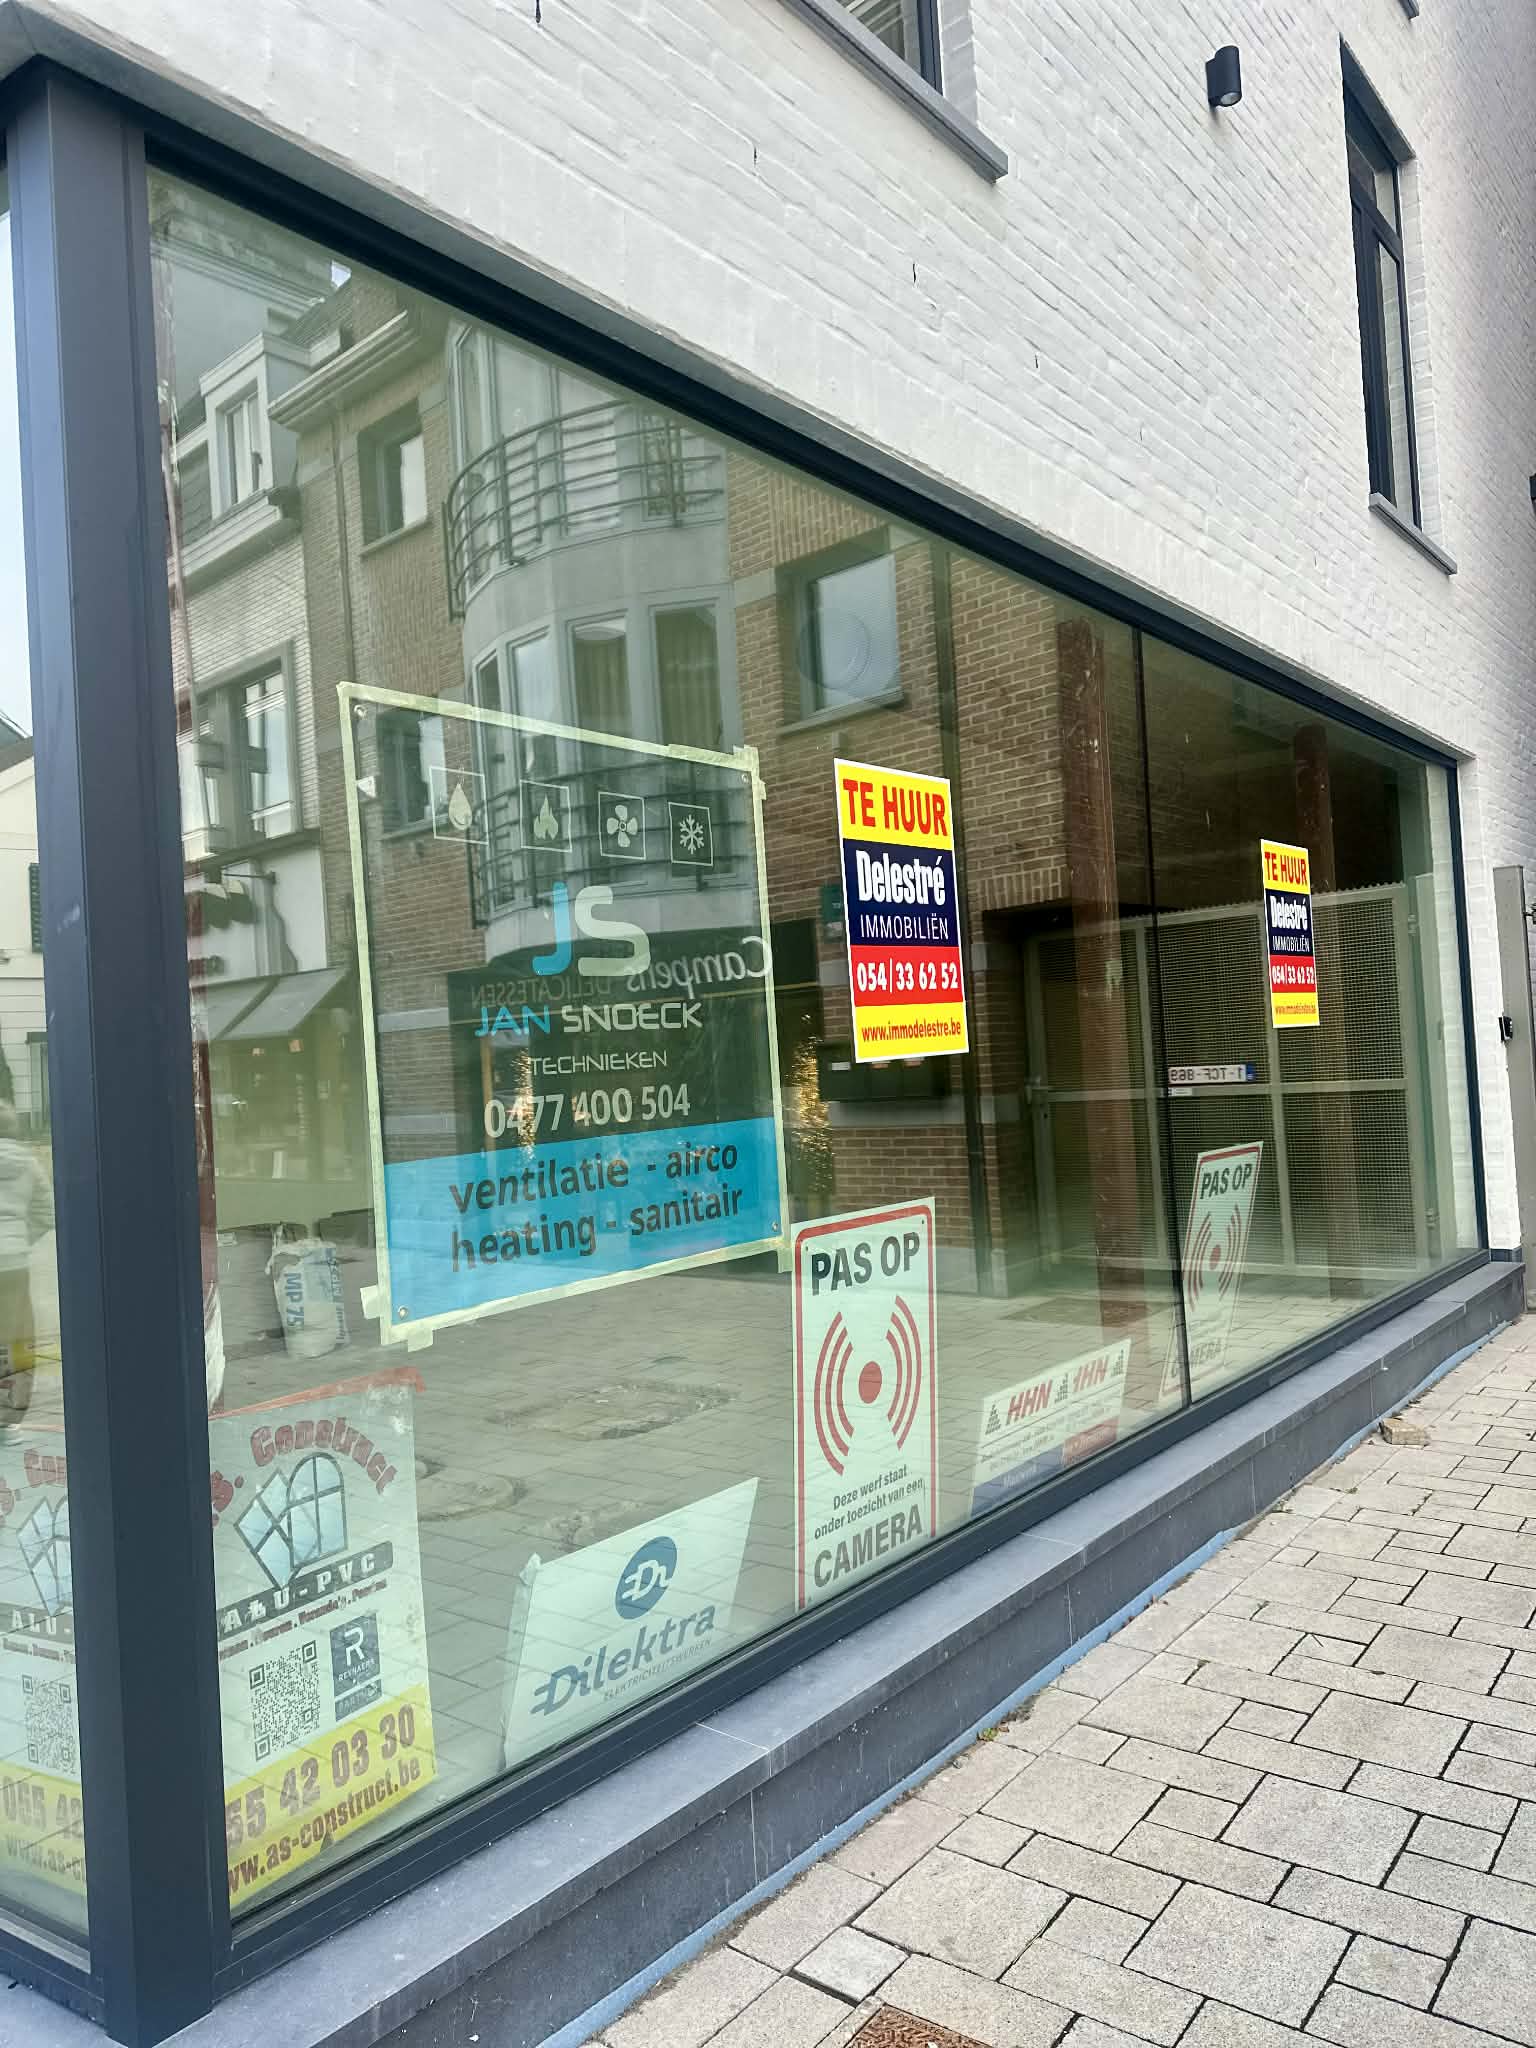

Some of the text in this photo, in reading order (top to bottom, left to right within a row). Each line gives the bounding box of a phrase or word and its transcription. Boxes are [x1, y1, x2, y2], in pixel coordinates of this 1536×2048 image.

[842, 779, 948, 836] TE HUUR
[855, 849, 946, 906] Delestré
[1264, 852, 1308, 885] TE HUUR
[860, 913, 949, 940] IMMOBILIËN
[1270, 895, 1308, 931] Delestré
[919, 962, 937, 990] 62
[941, 962, 959, 989] 52
[1297, 965, 1306, 984] 62
[1306, 966, 1315, 984] 52
[475, 1003, 702, 1037] JAN SNOECK
[861, 1016, 961, 1042] www.immodelestre.be
[529, 1050, 668, 1076] TECHNIEKEN
[484, 1083, 691, 1138] 0477 400 504
[449, 1154, 629, 1215] ventilatie
[665, 1141, 738, 1180] airco
[1200, 1163, 1253, 1199] PAS OP
[451, 1213, 596, 1273] heating
[630, 1184, 743, 1236] sanitair
[810, 1231, 920, 1297] PAS OP
[814, 1478, 923, 1540] onder toezicht van een
[833, 1463, 908, 1511] Deze werf staat
[814, 1503, 923, 1588] CAMERA
[530, 1605, 716, 1716] Dilektra
[279, 1757, 321, 1816] 42
[331, 1729, 370, 1789] 03
[379, 1704, 415, 1759] 30
